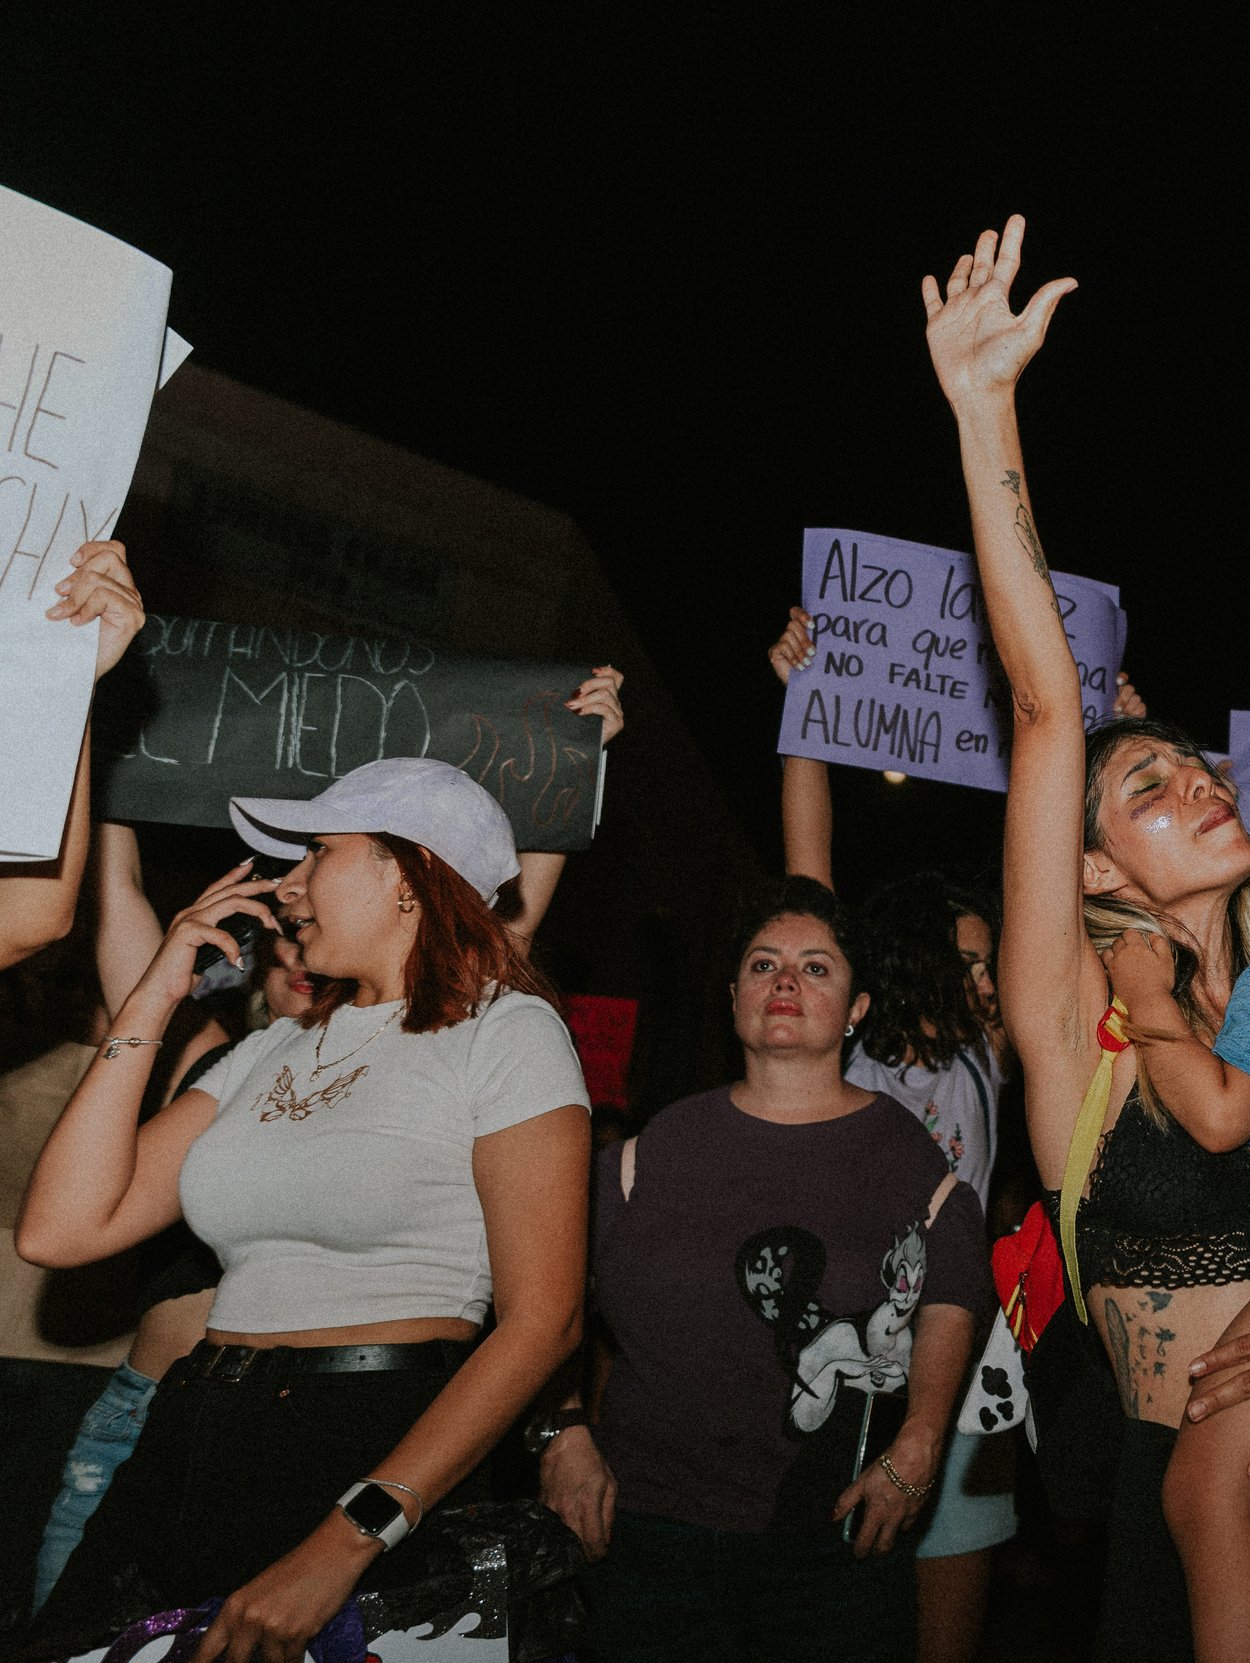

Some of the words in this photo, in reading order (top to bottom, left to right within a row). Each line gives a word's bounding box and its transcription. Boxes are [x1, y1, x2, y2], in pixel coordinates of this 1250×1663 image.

[818, 538, 914, 608] Alzo
[811, 612, 889, 648] para
[911, 628, 968, 669] que
[823, 651, 864, 678] NO
[888, 662, 970, 700] FALTE
[800, 688, 943, 764] ALUMNA
[954, 727, 990, 754] en
